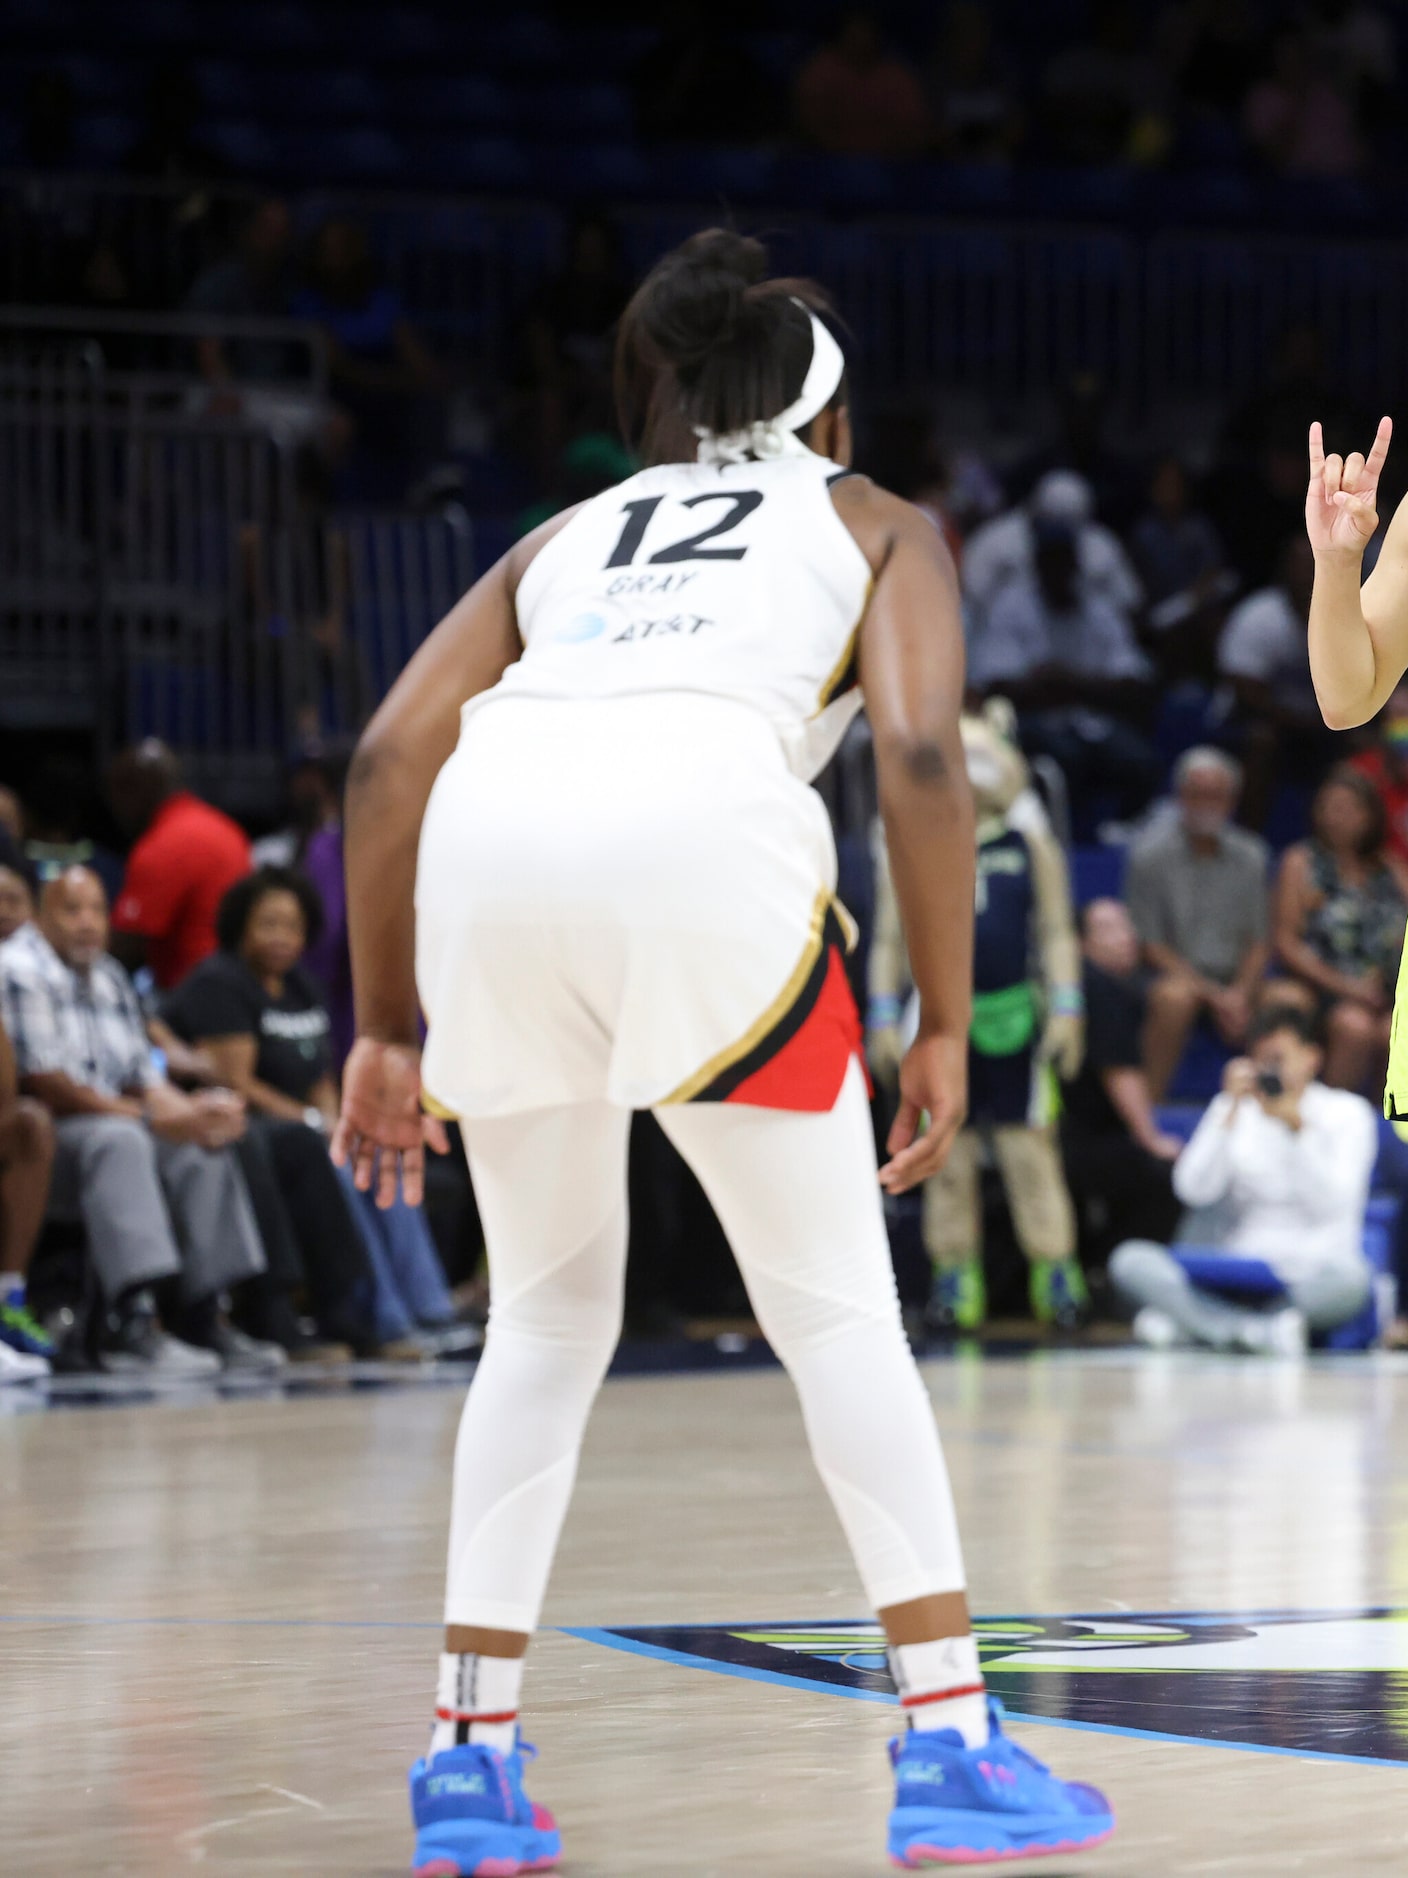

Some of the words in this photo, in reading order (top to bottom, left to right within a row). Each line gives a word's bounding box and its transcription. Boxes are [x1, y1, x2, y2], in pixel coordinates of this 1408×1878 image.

[602, 489, 764, 571] 12
[606, 571, 698, 597] GRAY
[611, 612, 716, 645] AT&T
